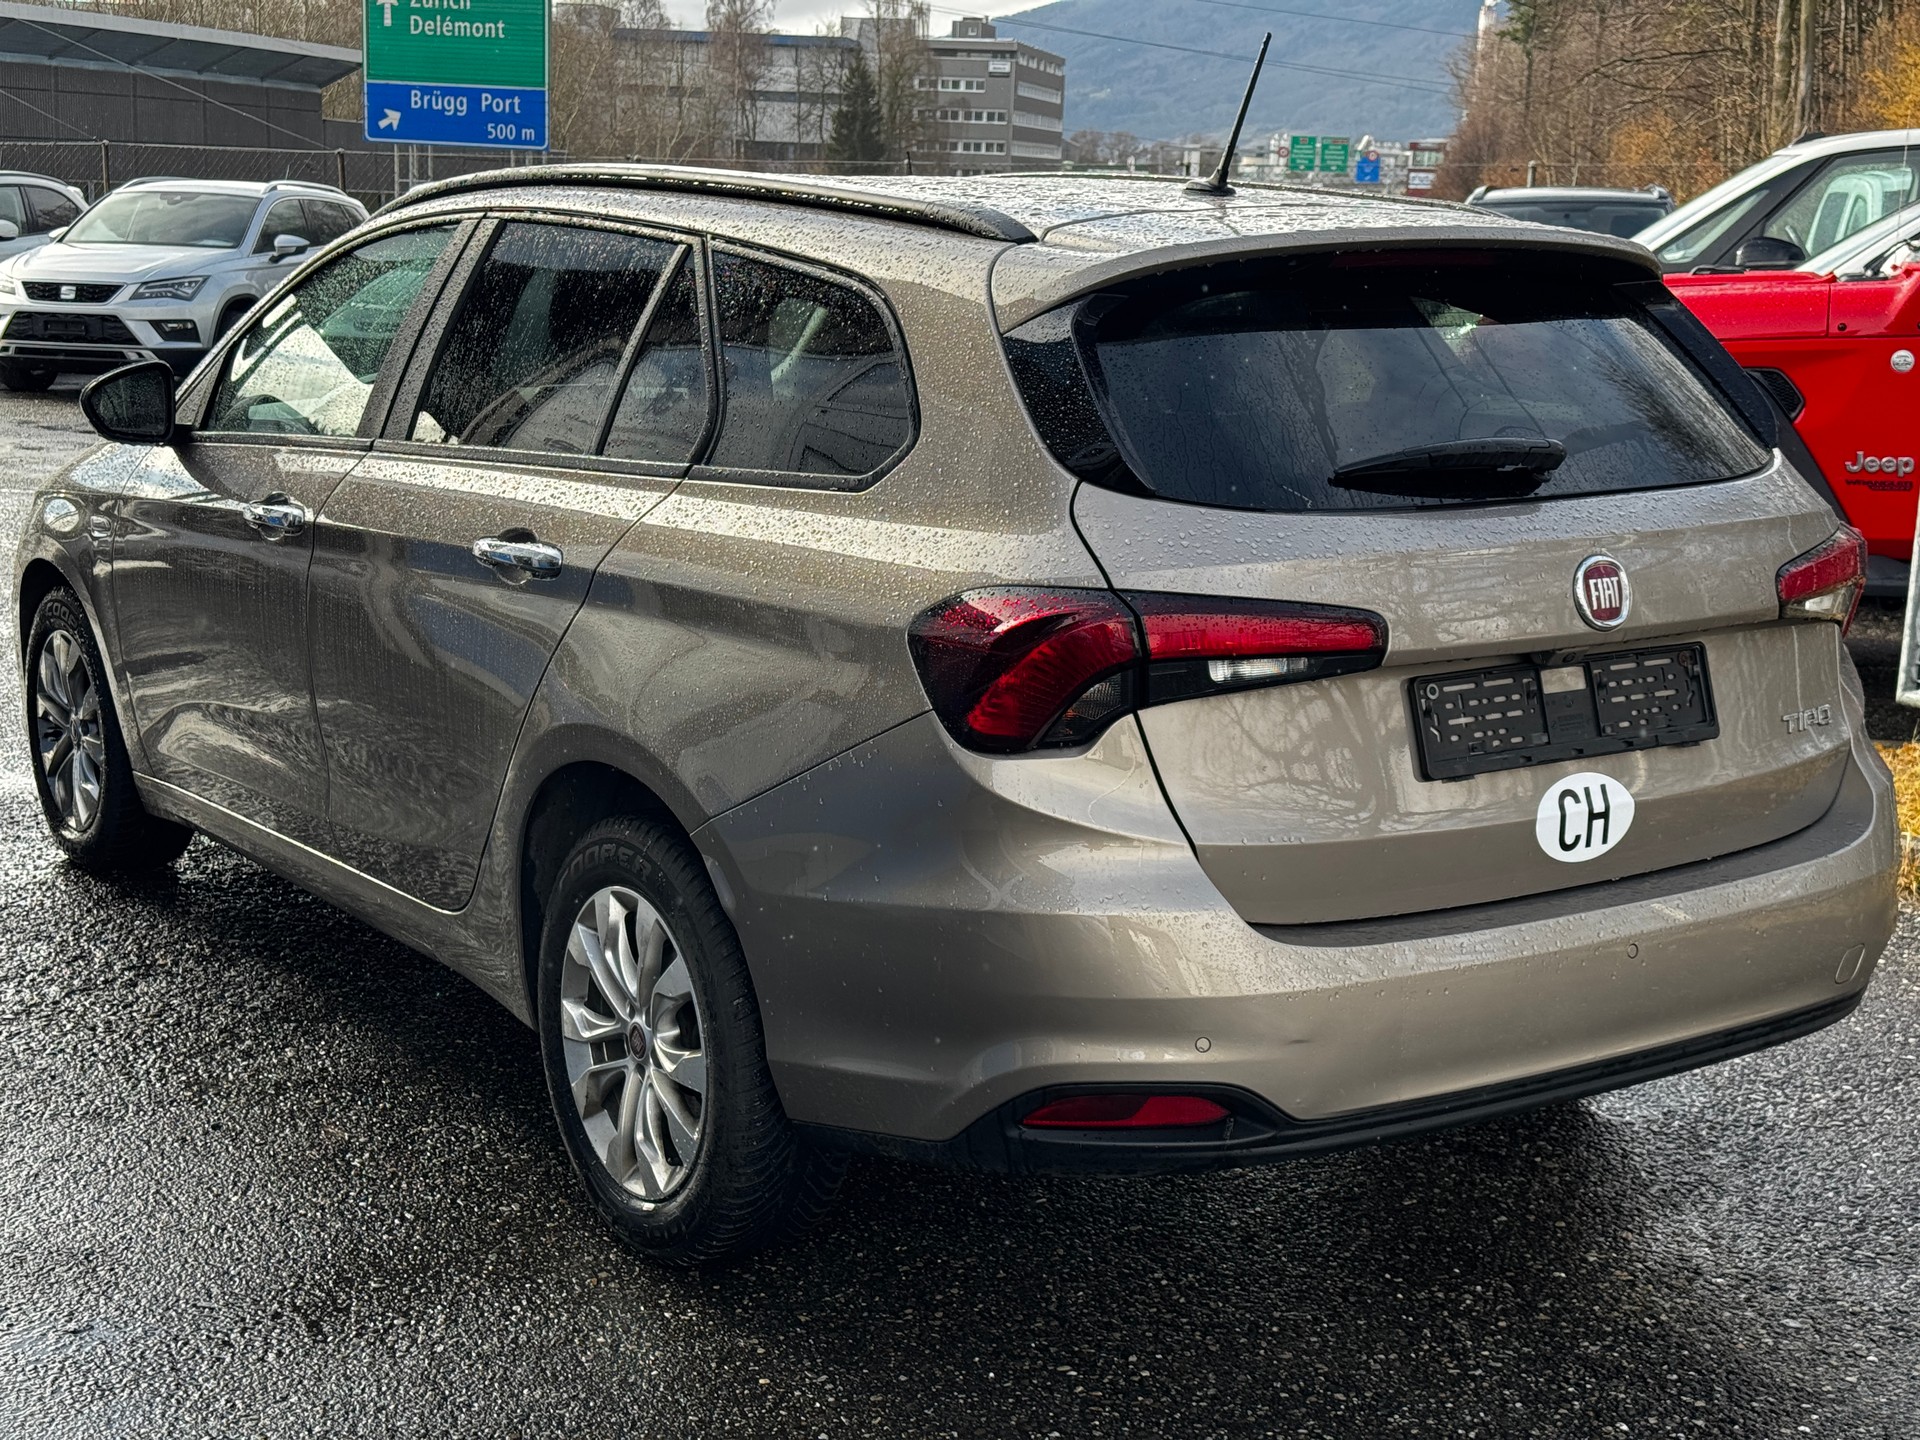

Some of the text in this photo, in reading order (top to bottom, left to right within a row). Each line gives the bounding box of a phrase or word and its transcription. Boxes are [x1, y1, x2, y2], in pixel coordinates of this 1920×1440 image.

[410, 14, 505, 39] Delémont
[410, 89, 522, 117] Brügg Port
[487, 123, 536, 141] 500 m
[1845, 451, 1914, 477] Jeep
[1589, 577, 1620, 610] FIAT
[1782, 704, 1832, 734] TIPO
[1558, 784, 1610, 852] CH
